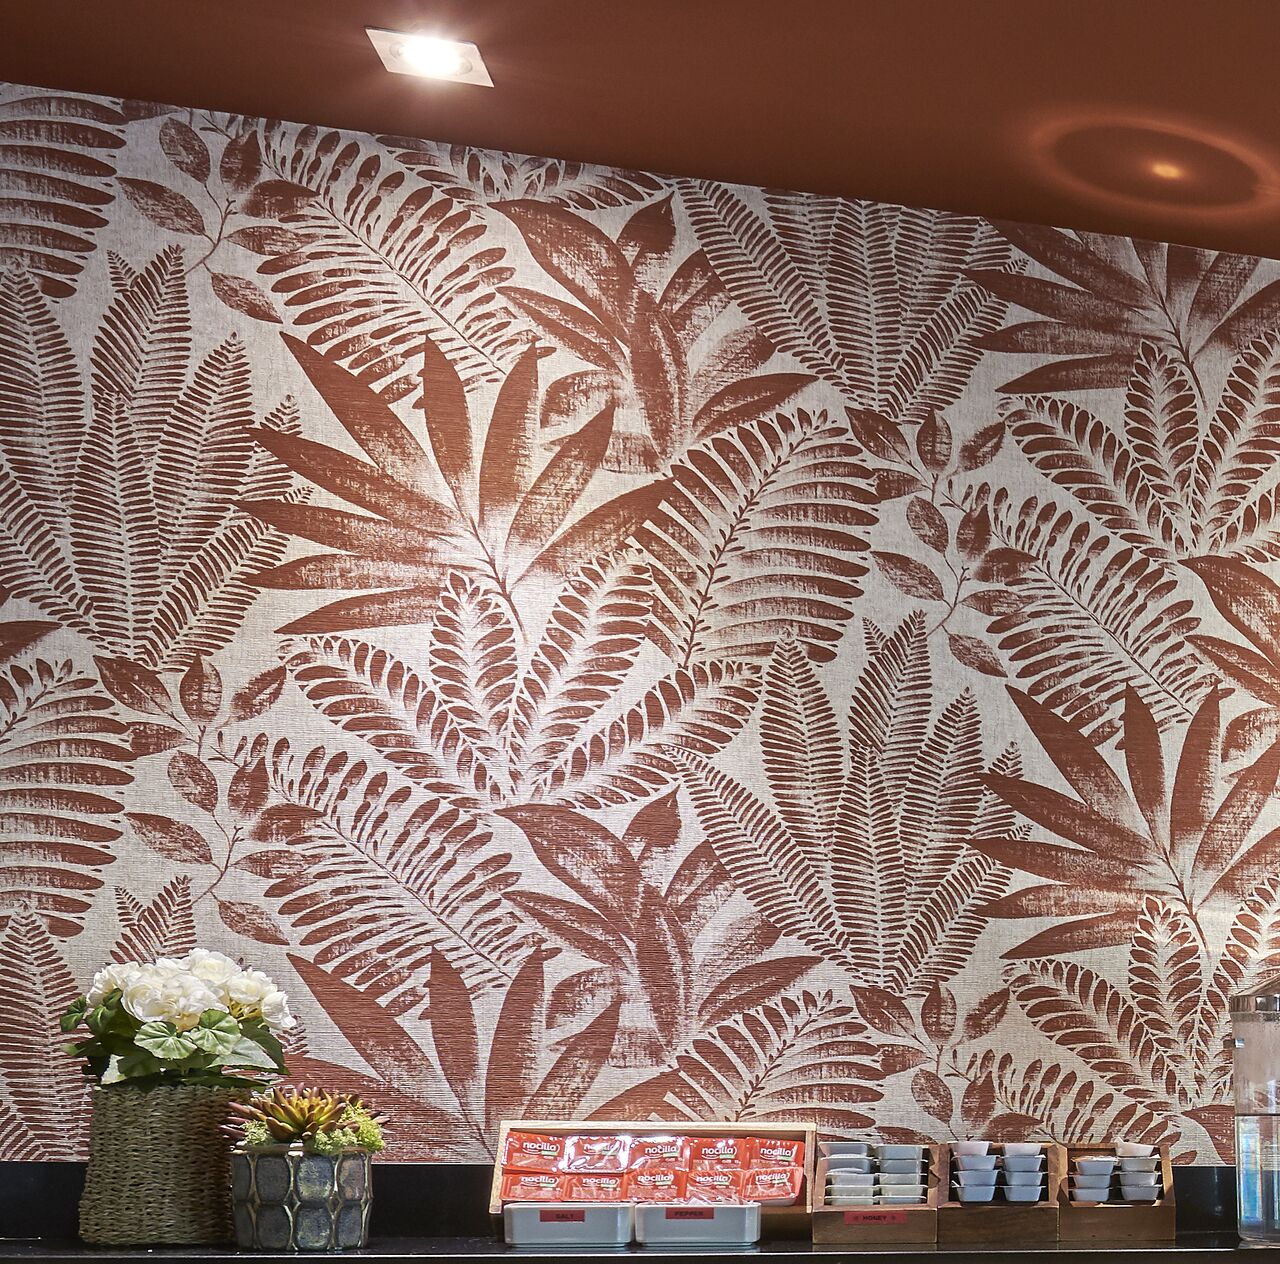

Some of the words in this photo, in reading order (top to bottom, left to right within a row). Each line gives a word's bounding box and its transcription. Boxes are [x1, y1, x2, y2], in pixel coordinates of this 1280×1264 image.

[522, 1141, 556, 1152] nocilla
[644, 1145, 677, 1154] nocilla
[701, 1146, 733, 1155] nocilla
[760, 1146, 792, 1156] nocilla
[521, 1176, 555, 1184] nocilla
[582, 1177, 616, 1185] nocilla
[637, 1174, 671, 1182] nocilla
